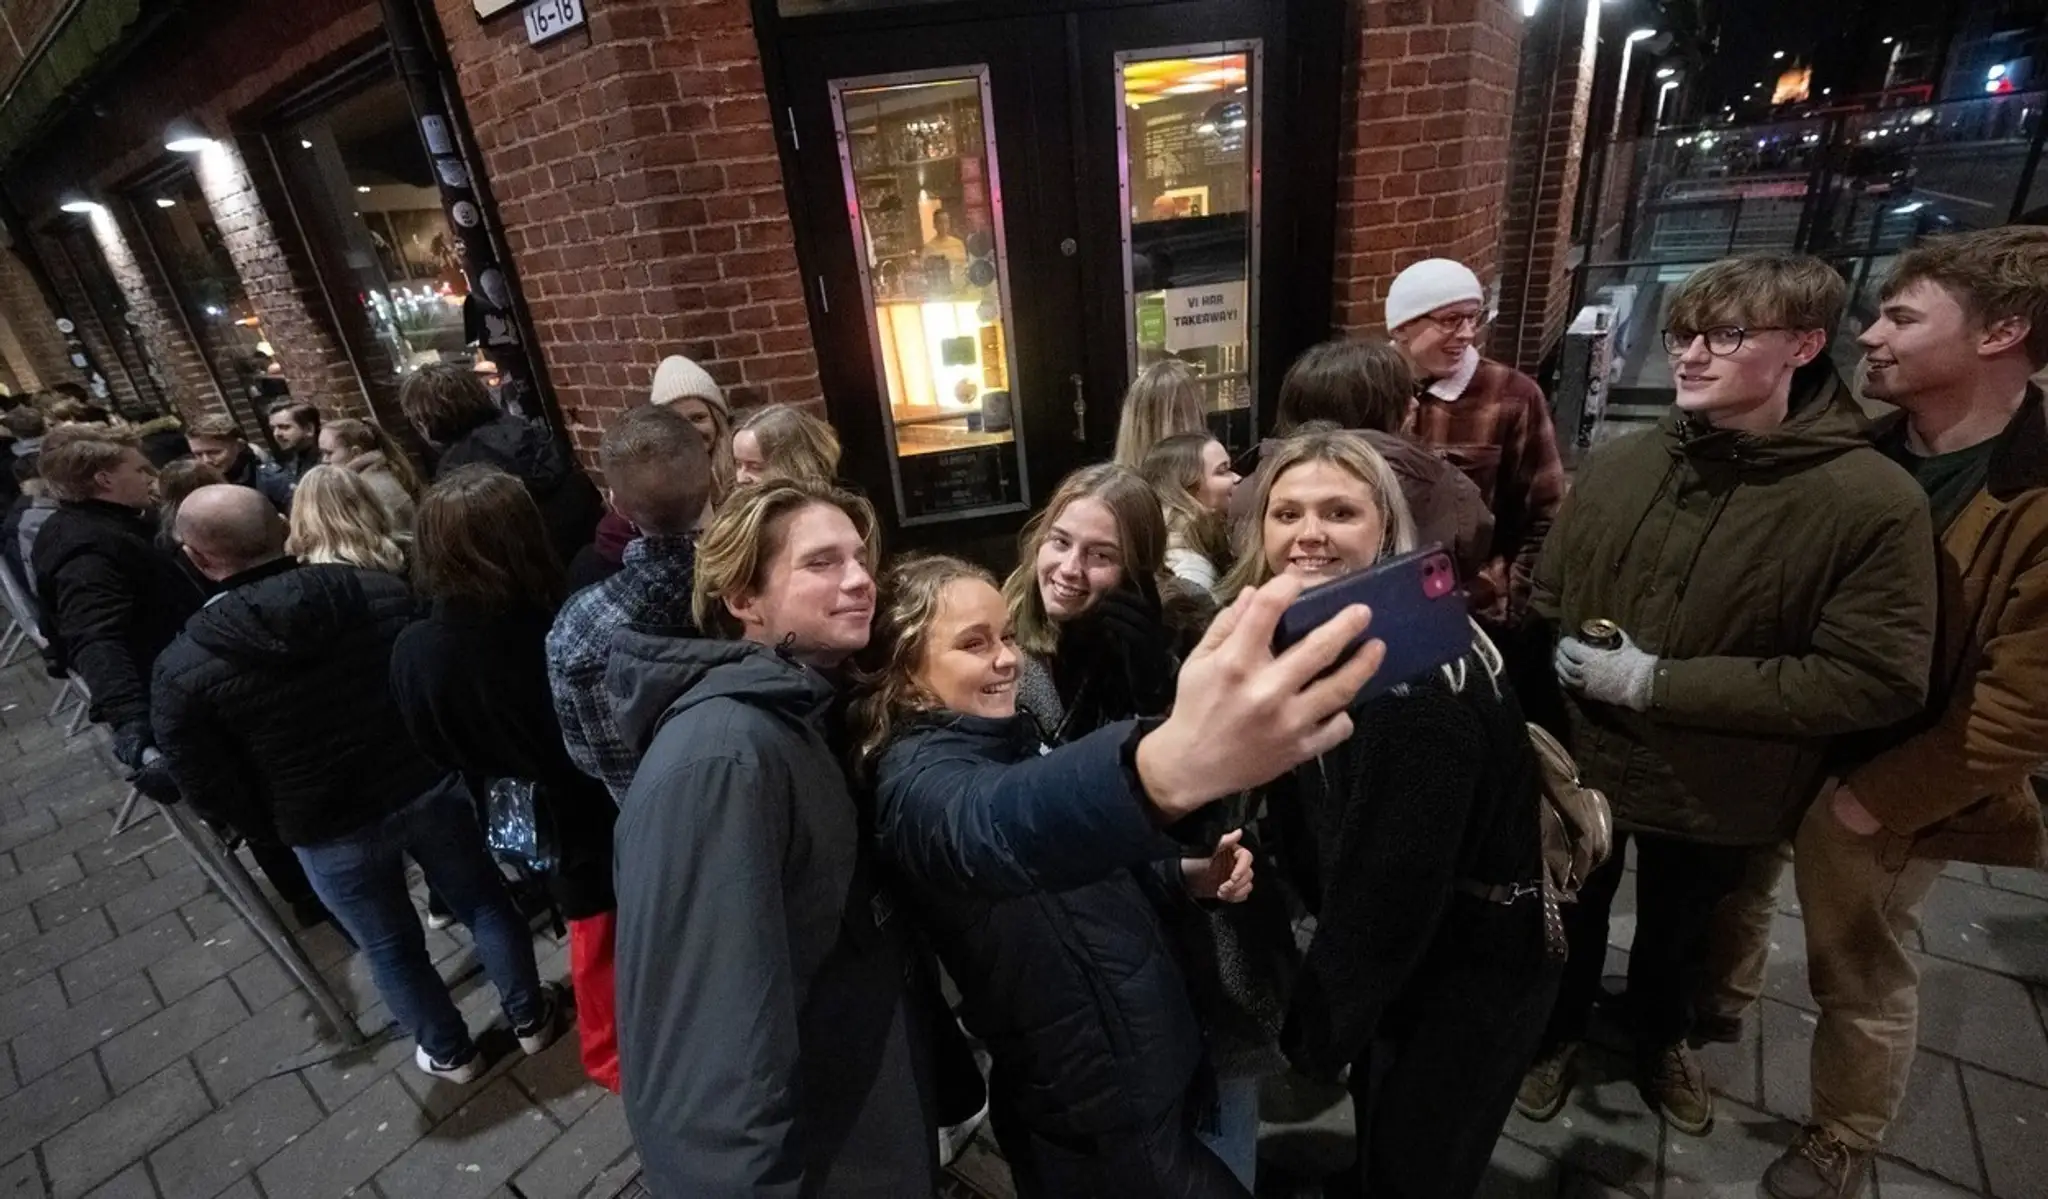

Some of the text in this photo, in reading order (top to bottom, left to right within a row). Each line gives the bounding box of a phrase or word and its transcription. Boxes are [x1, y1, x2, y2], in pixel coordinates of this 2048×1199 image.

[530, 0, 574, 36] 16-18
[1187, 294, 1224, 309] VI HAR
[1173, 309, 1238, 328] TAKEAWAY!
